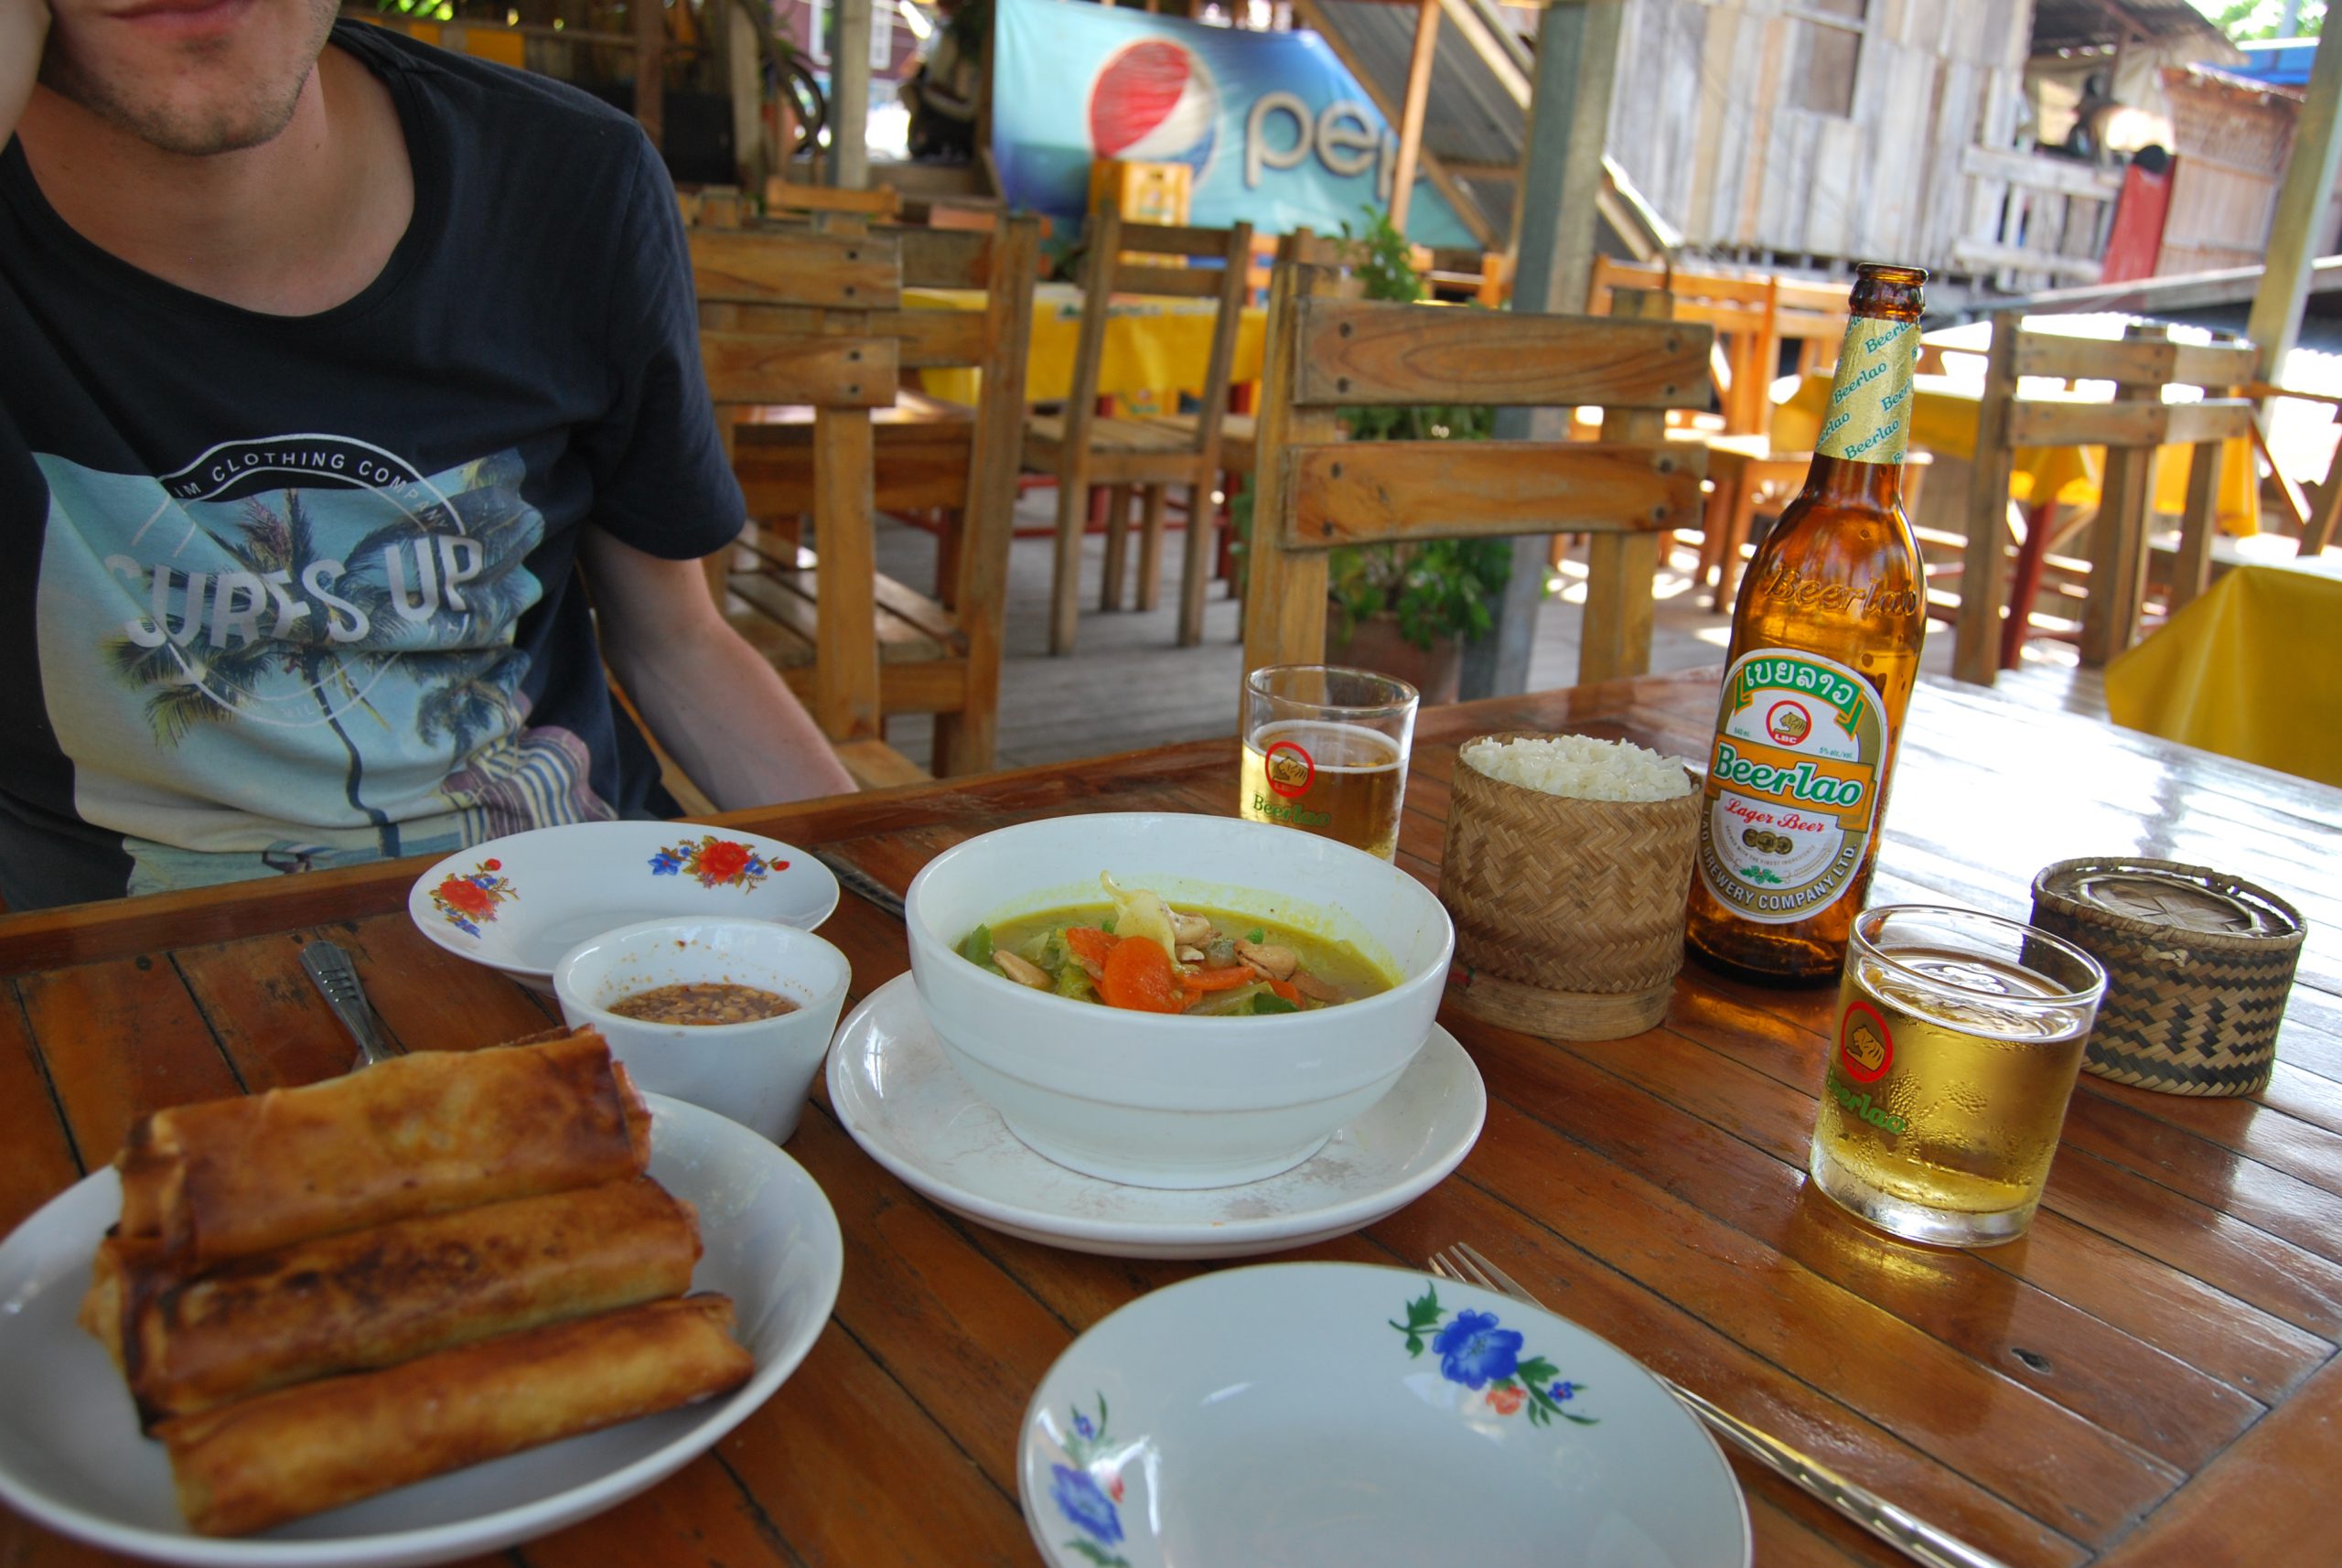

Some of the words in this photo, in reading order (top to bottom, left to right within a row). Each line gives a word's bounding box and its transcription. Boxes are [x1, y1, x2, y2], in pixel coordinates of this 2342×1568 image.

[1834, 363, 1886, 403] Beerlao
[1845, 420, 1899, 459] Beerlao
[174, 482, 201, 497] IM
[211, 453, 345, 482] CLOTHING
[359, 460, 448, 527] COMPANY
[104, 553, 370, 648] SURFS
[384, 535, 483, 621] UP
[1766, 563, 1917, 618] Beerlao
[1746, 661, 1853, 705] ເບຍລາວ
[1714, 744, 1862, 806] Beerlao
[1253, 794, 1332, 826] Beerlao
[1724, 799, 1774, 823] Lager
[1777, 812, 1824, 833] Beer
[1703, 847, 1756, 905] BREWERY
[1758, 873, 1835, 911] COMPANY
[1832, 842, 1859, 878] LTD.
